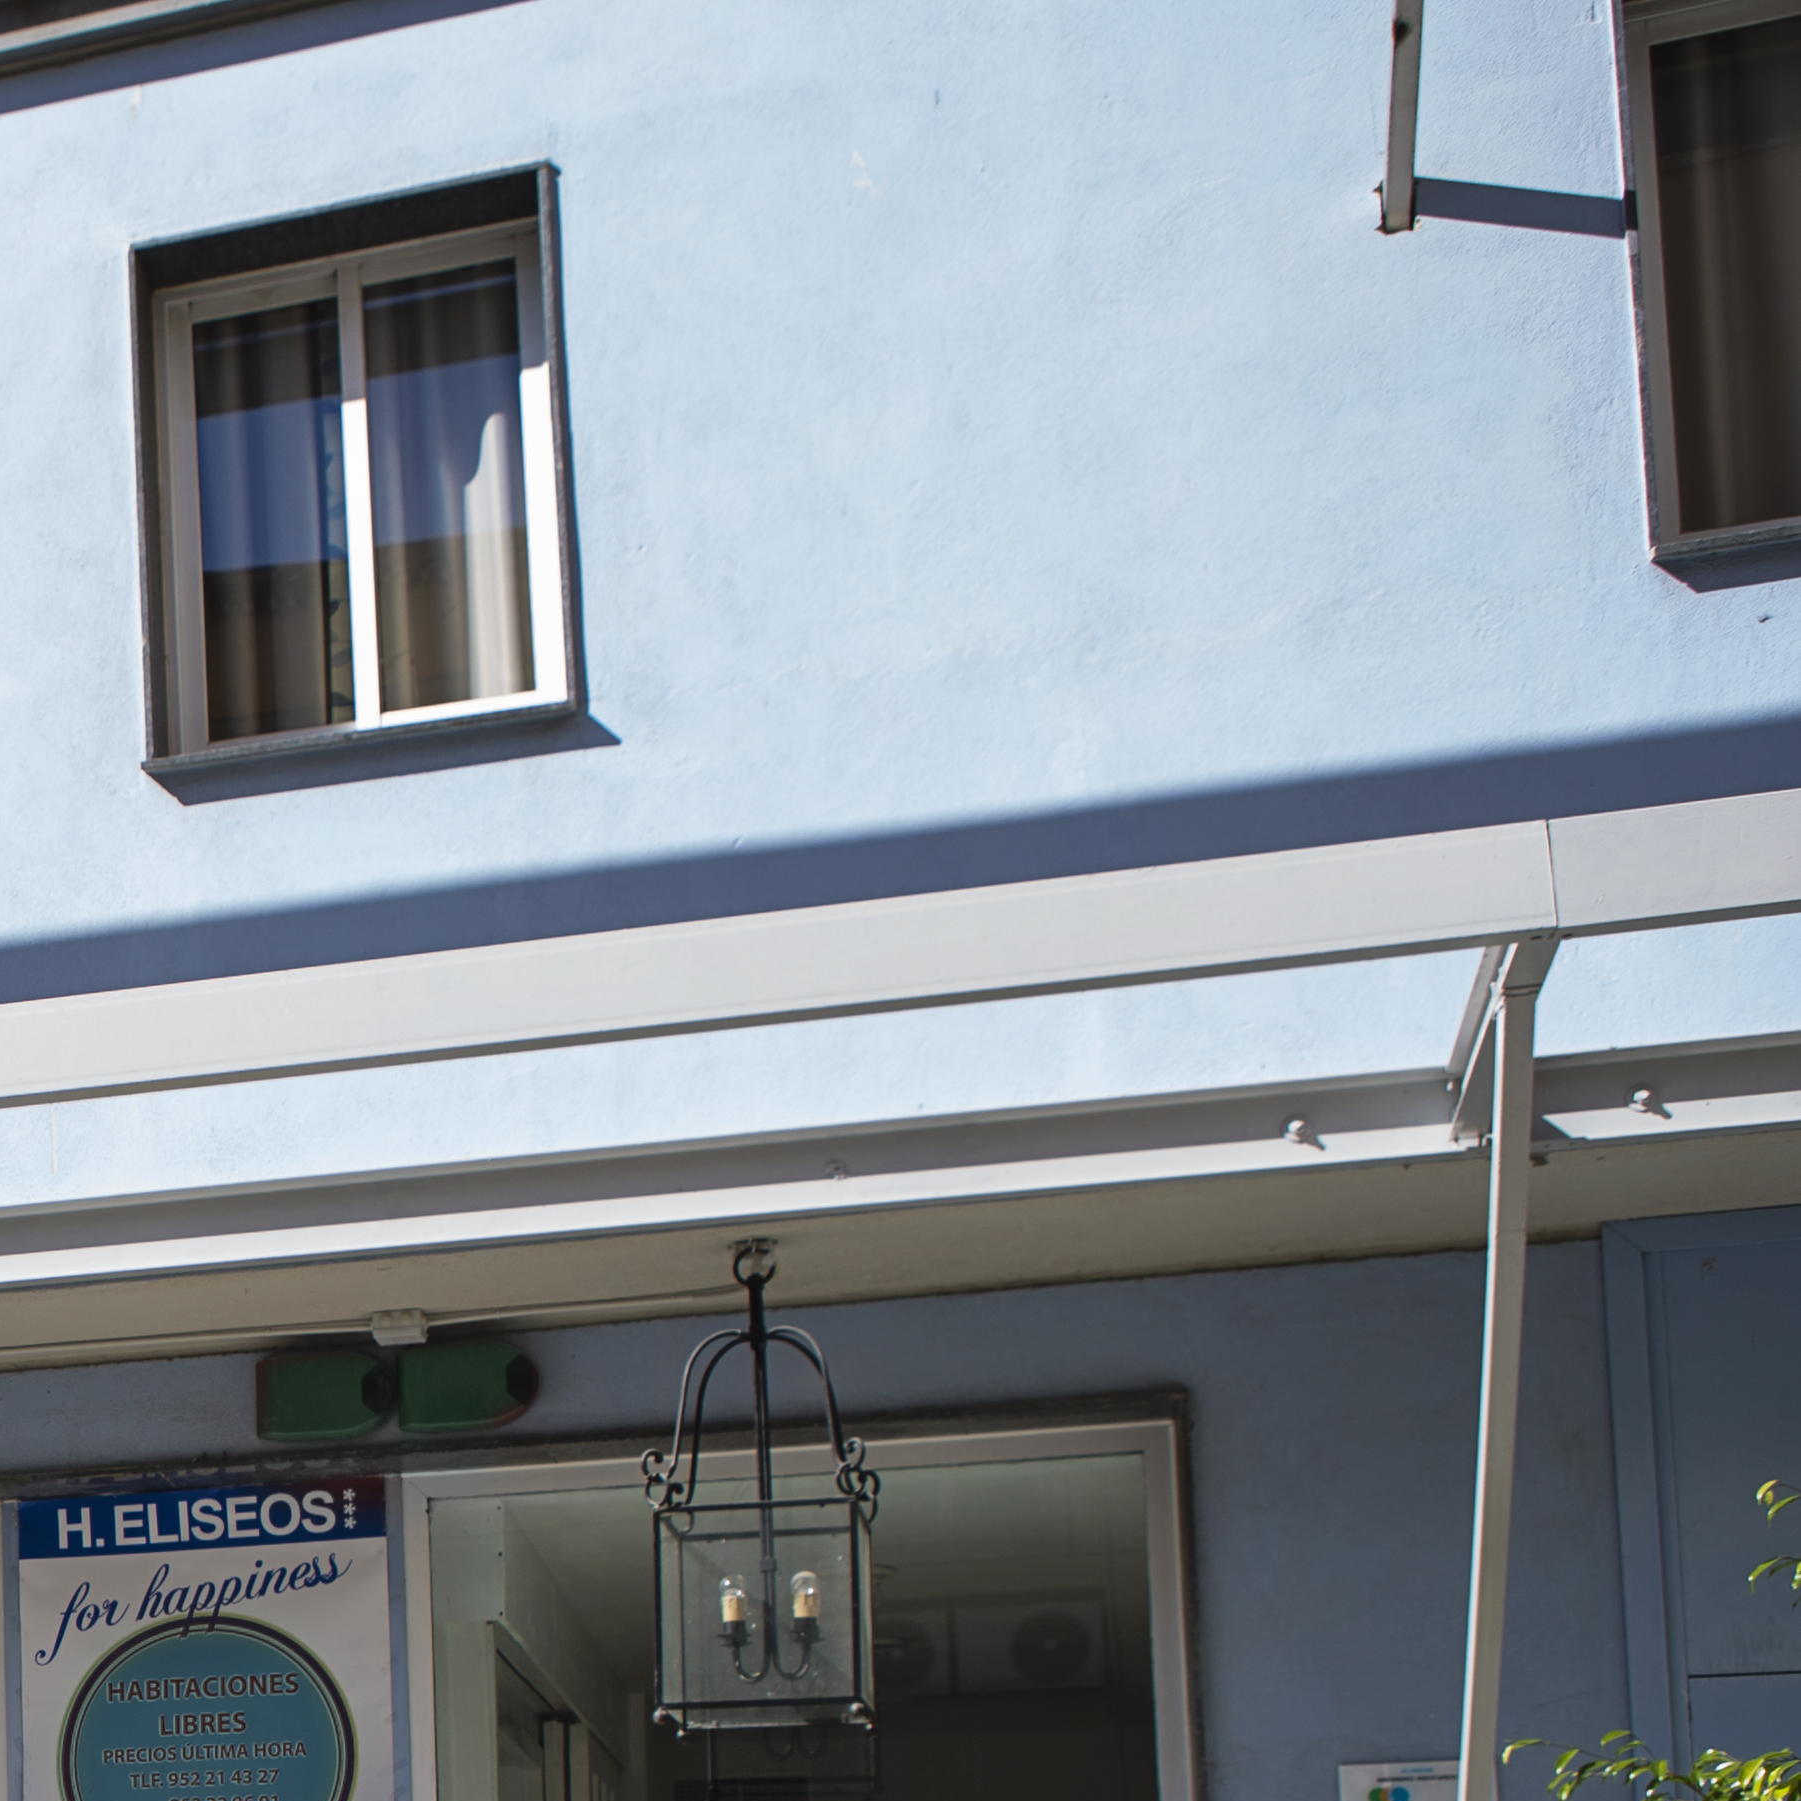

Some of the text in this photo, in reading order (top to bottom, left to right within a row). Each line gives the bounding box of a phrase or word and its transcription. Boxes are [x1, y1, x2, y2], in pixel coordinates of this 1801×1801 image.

[57, 1490, 336, 1549] H. ELISEOS
[35, 1553, 354, 1666] for happiness
[107, 1672, 300, 1703] HABITACIONES
[159, 1711, 247, 1736] LIBRES
[102, 1741, 307, 1765] PRECIOS ÚLTIMA HORA
[129, 1768, 279, 1789] TLF. 952 21 43 27
